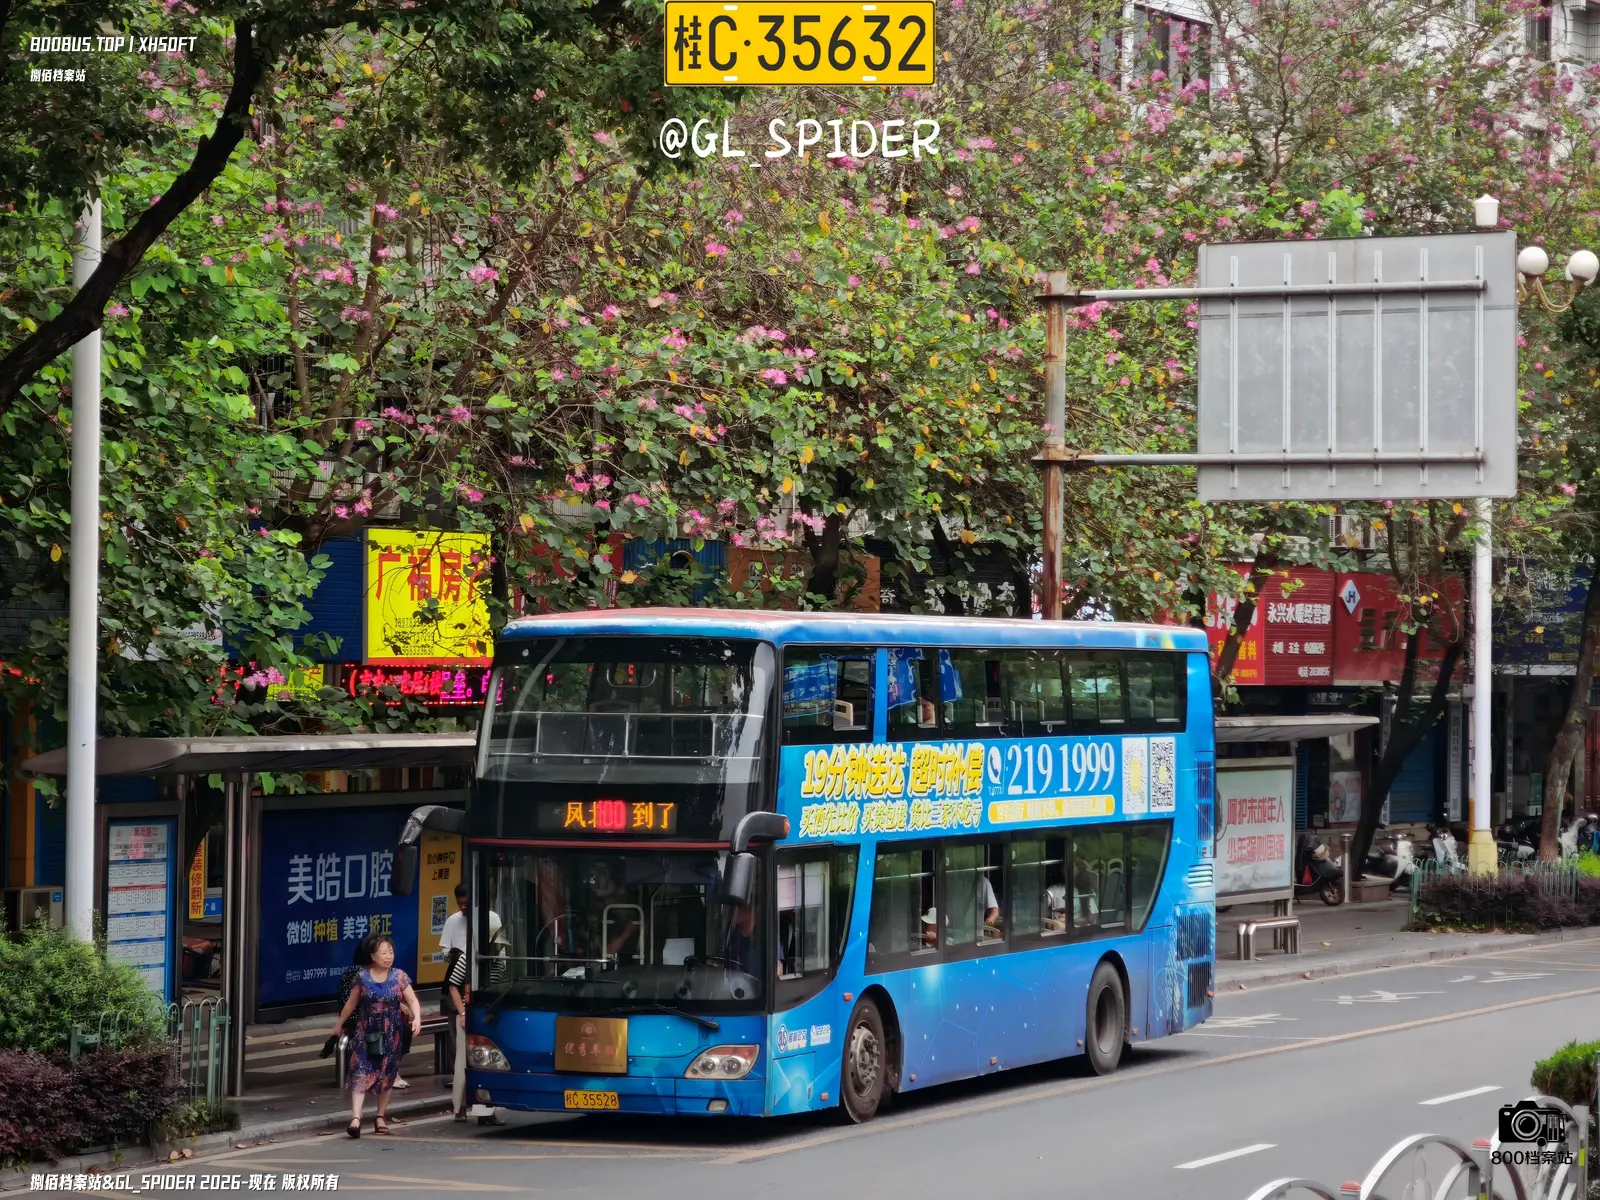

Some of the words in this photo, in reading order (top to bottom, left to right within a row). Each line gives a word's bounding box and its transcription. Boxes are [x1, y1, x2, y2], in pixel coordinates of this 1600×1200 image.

[802, 743, 907, 801] 19分钟送达
[907, 742, 985, 797] 超时补偿
[1007, 743, 1053, 796] 219
[1058, 741, 1115, 793] 1999
[1227, 796, 1285, 825] 呵护未成年人
[1226, 834, 1285, 865] 少年强则国强
[287, 849, 394, 906] 美皓口腔
[286, 917, 339, 946] 微创种植
[342, 914, 393, 940] 美学矫正
[302, 967, 328, 980] 3897999
